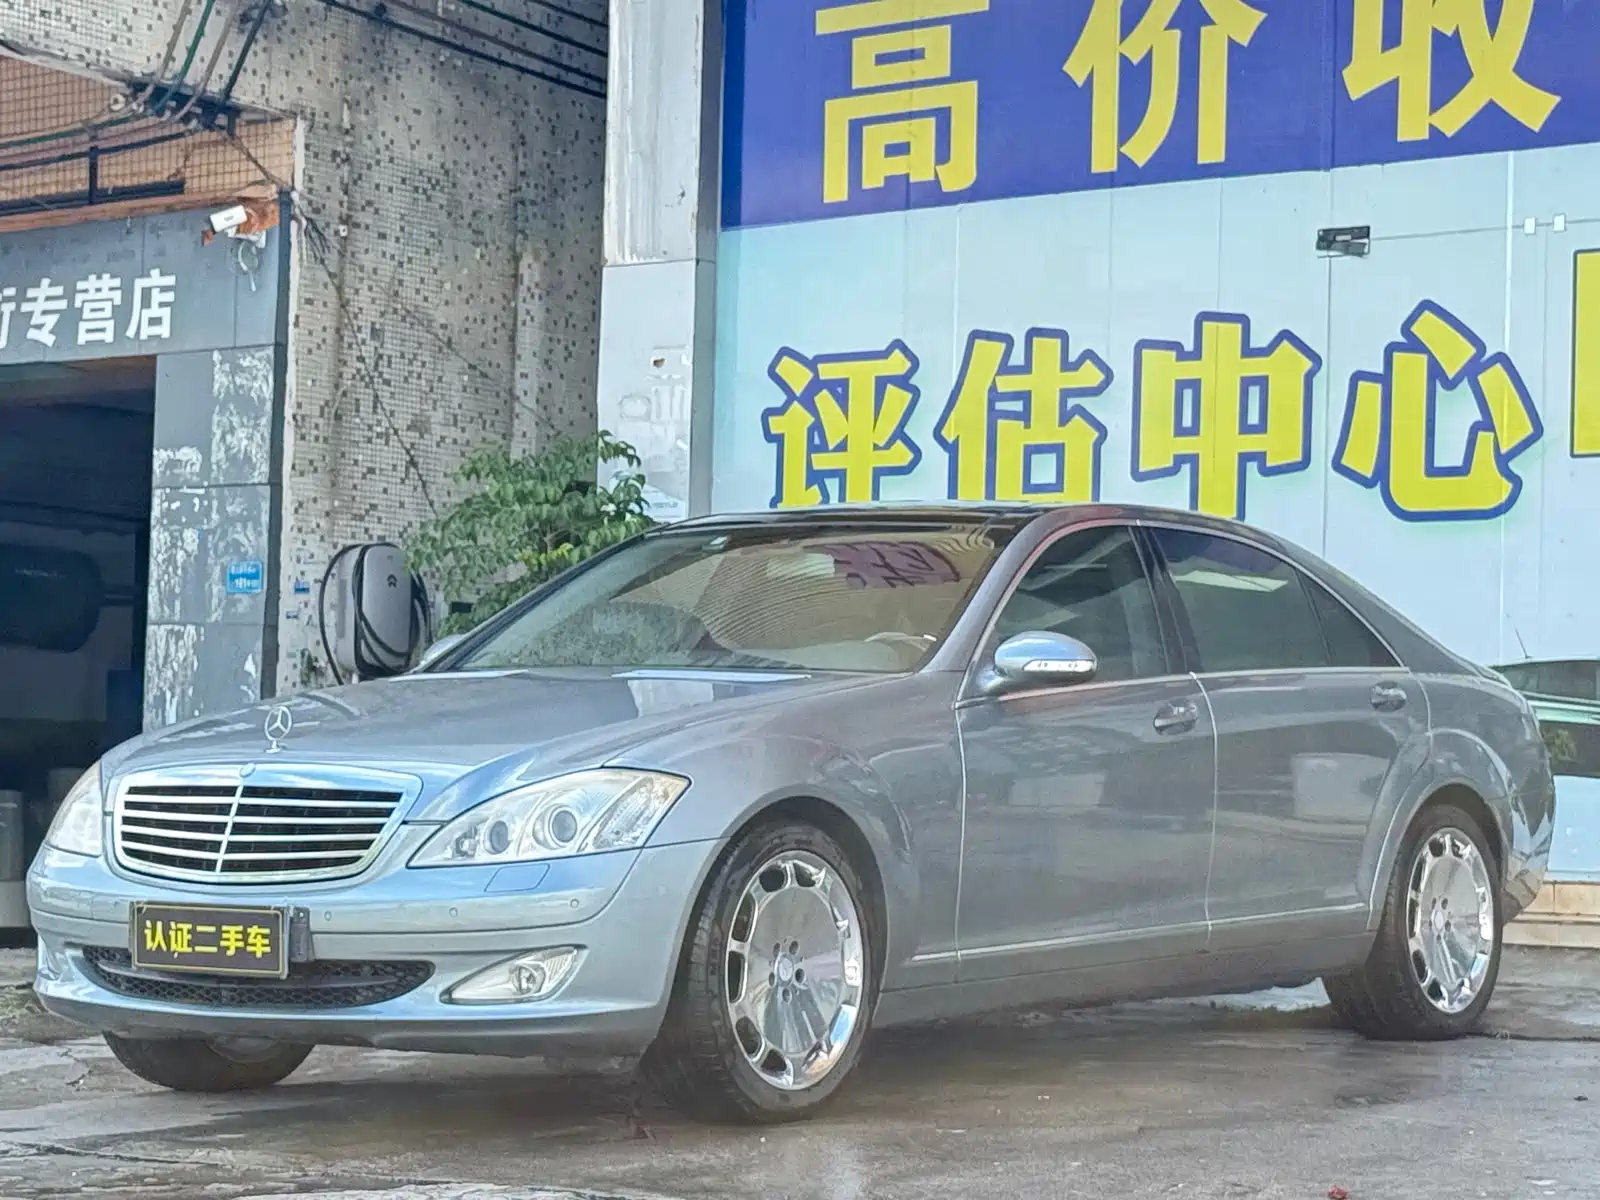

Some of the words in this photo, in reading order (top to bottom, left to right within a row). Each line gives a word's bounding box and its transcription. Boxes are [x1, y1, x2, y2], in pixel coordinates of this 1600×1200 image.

[815, 0, 1560, 204] 高价收
[761, 300, 1543, 522] 评估中心
[144, 919, 271, 959] 认证二手车
